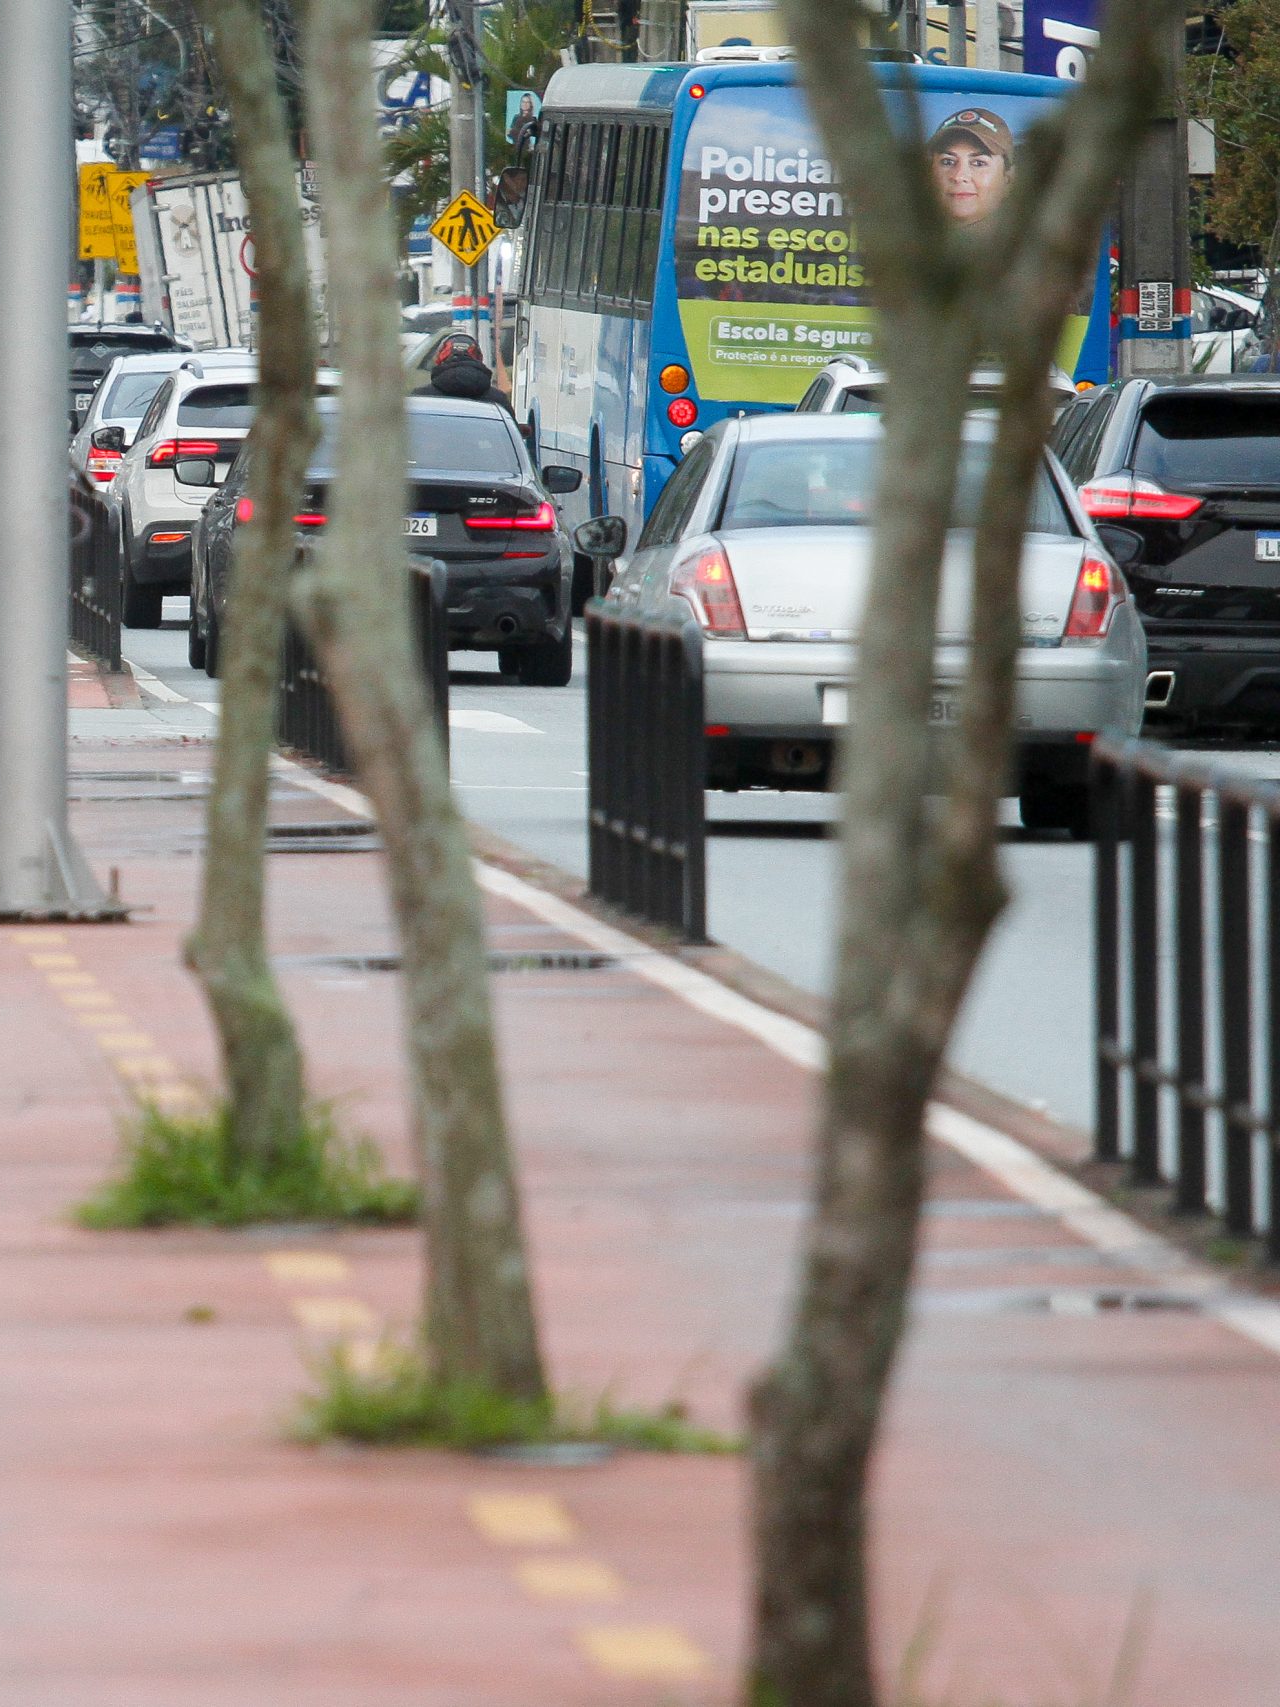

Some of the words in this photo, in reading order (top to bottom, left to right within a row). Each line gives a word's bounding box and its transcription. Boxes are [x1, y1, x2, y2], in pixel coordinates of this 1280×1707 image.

[698, 187, 854, 223] presen
[697, 226, 760, 249] nas
[718, 322, 788, 342] Escola
[794, 325, 872, 348] Segura
[716, 350, 767, 362] Proteção
[780, 354, 787, 362] a
